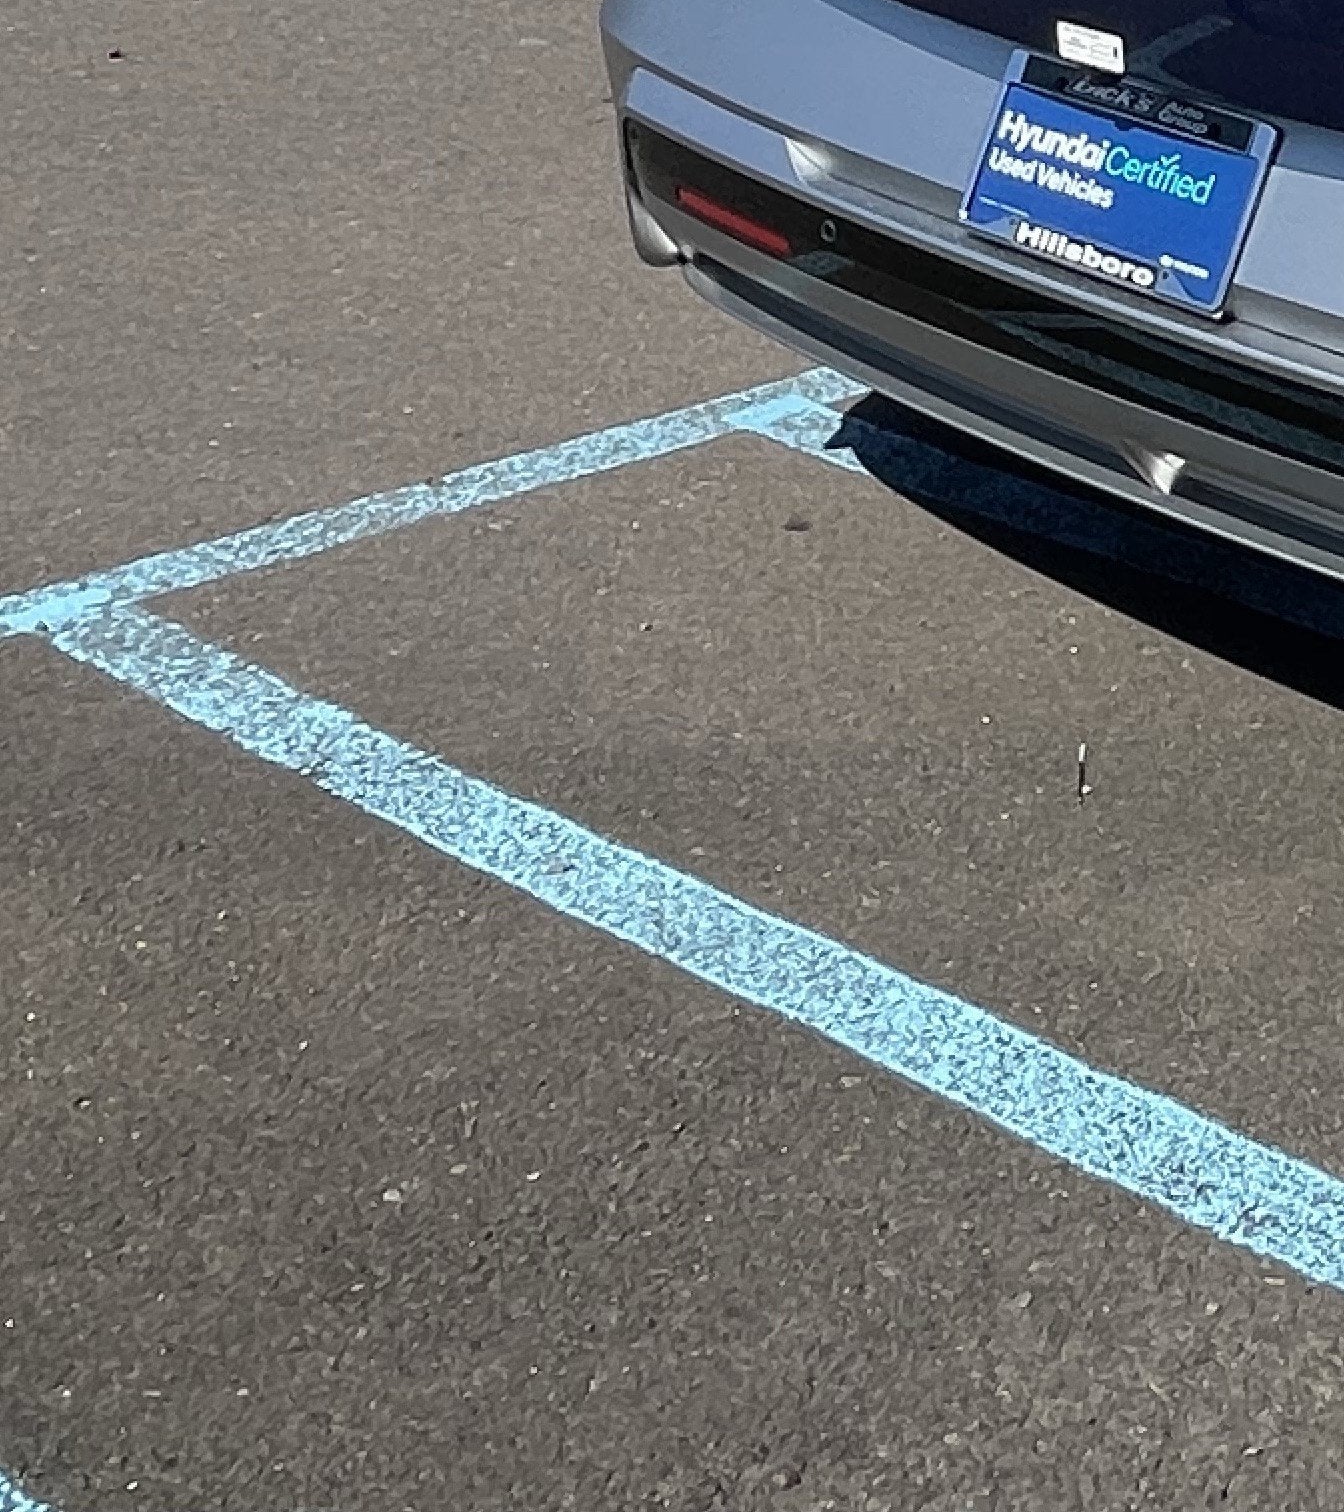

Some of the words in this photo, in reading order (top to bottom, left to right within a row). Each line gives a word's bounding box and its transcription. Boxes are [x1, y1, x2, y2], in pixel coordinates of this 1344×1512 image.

[988, 146, 1039, 183] Used
[1036, 160, 1115, 209] Vehicles
[999, 110, 1110, 172] Hyundai
[1105, 146, 1217, 206] Certified
[1015, 222, 1155, 287] Hillsboro
